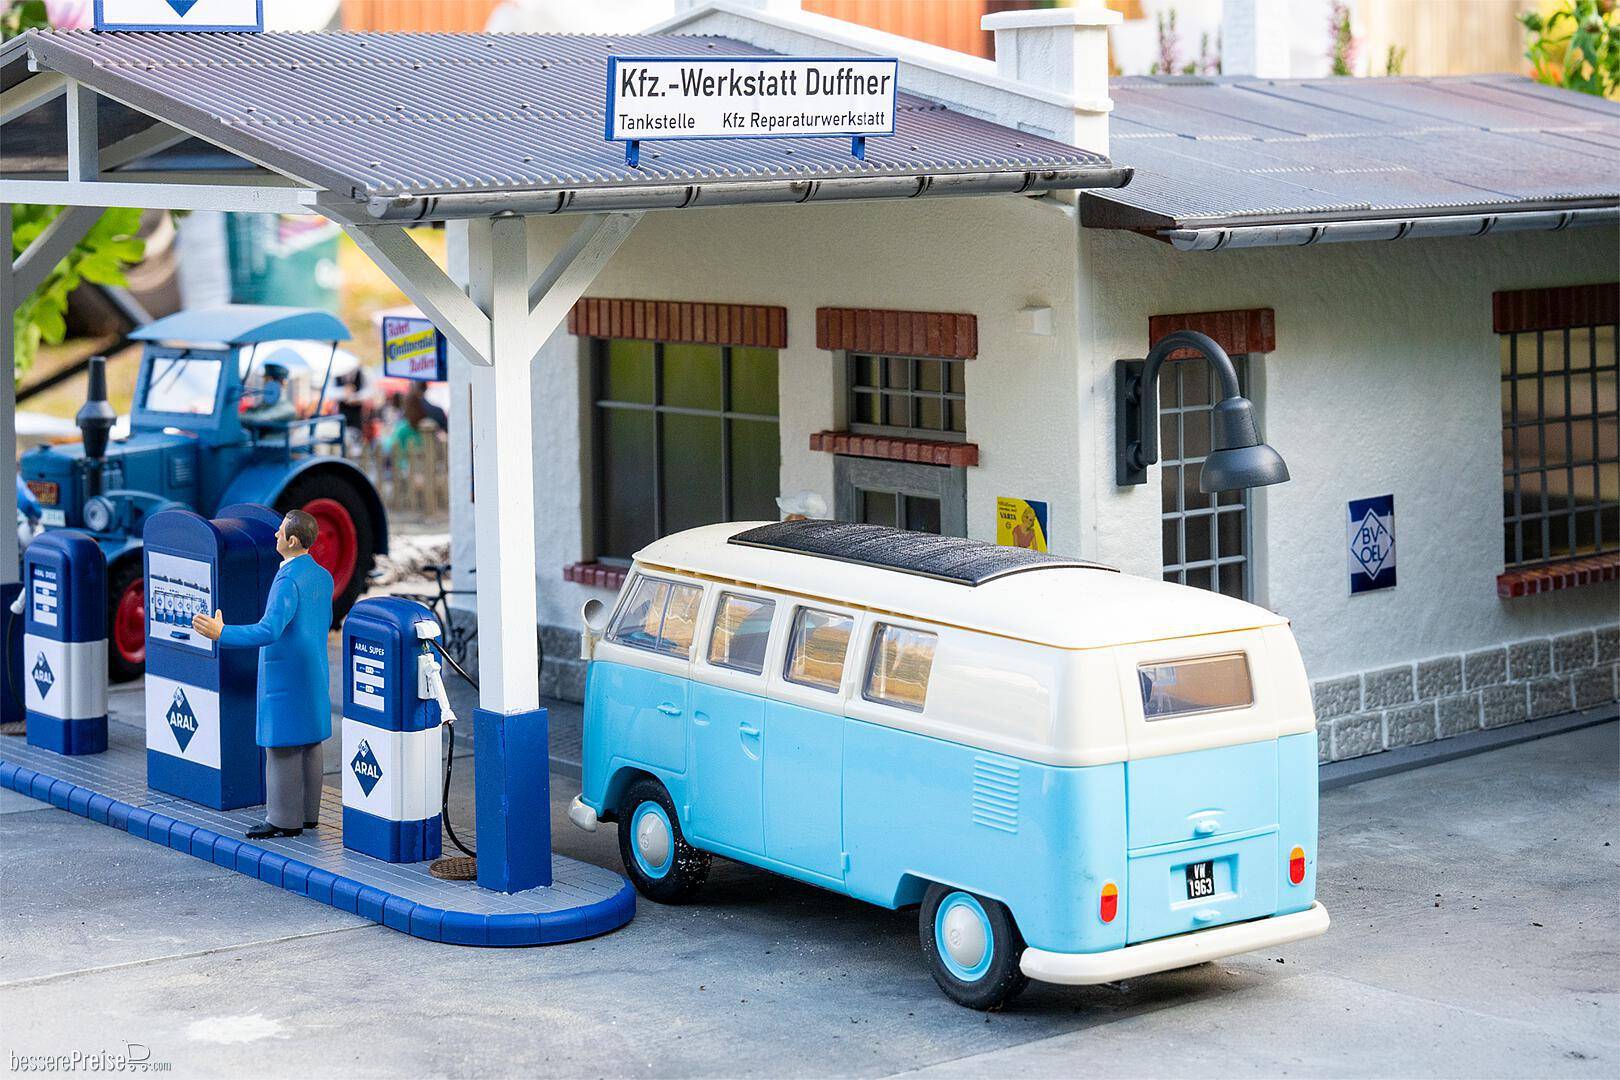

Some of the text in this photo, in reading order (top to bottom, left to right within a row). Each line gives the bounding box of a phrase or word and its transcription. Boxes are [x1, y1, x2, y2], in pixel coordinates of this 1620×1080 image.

[621, 67, 890, 97] Kfz.-Werkstatt Duffner
[619, 111, 885, 131] Tankstelle Kfz Reparaturwerkstatt
[1361, 544, 1382, 563] OEL
[354, 642, 368, 653] ARAL
[34, 668, 53, 685] ARAL
[169, 711, 196, 732] ARAL
[354, 760, 380, 779] ARAL
[1189, 877, 1212, 897] 1963
